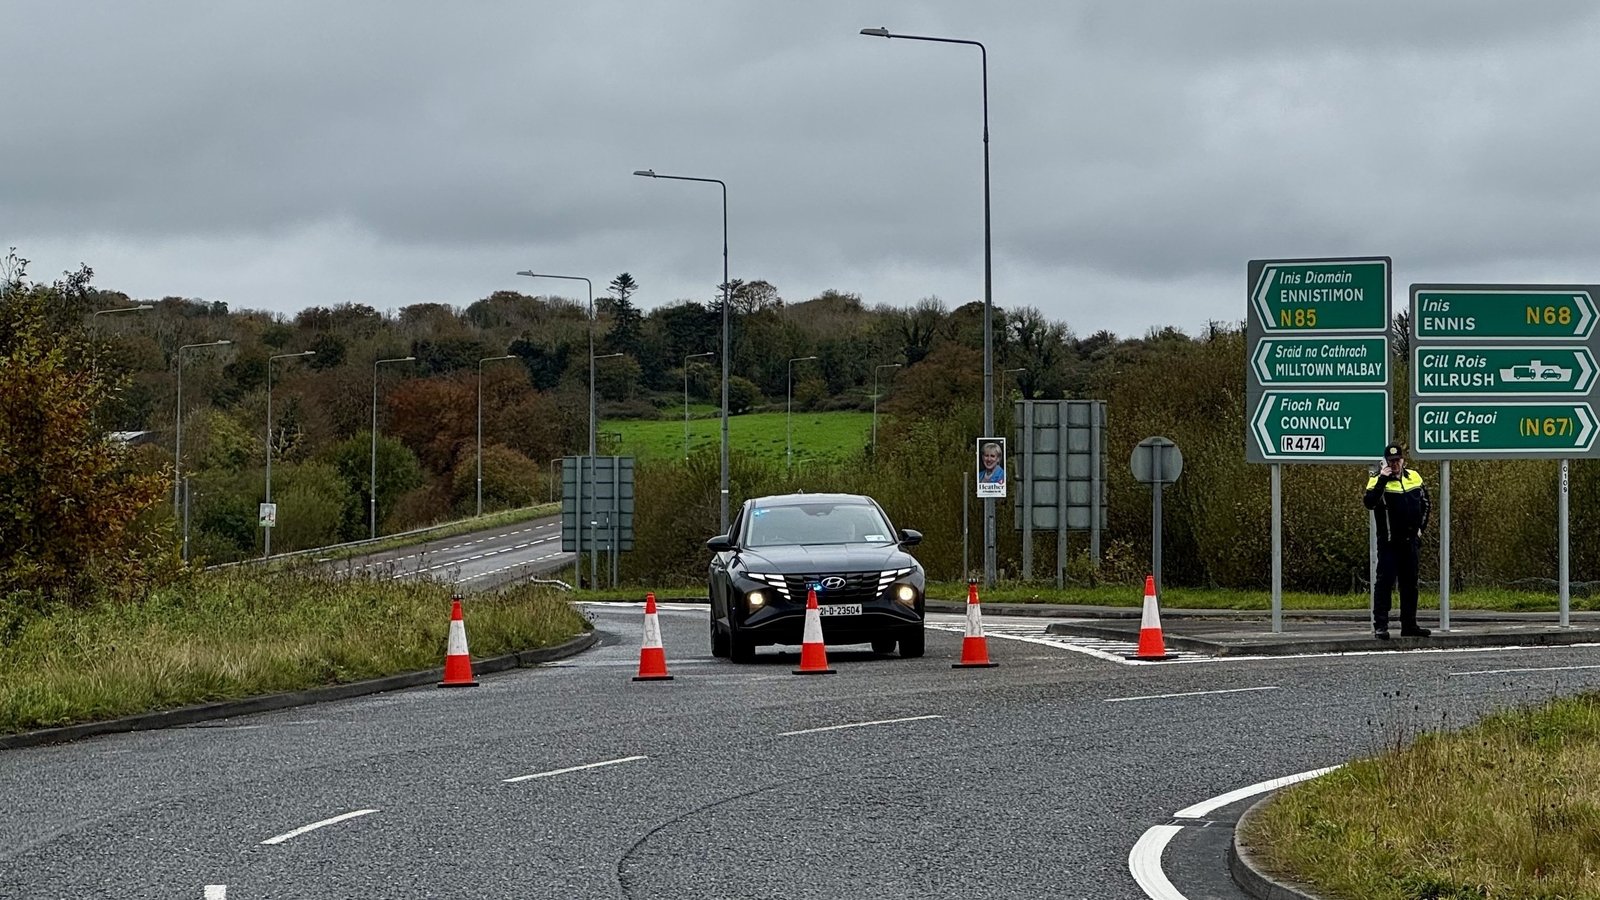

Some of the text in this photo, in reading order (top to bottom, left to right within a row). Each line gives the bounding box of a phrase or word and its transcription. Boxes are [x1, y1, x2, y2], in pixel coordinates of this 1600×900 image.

[1280, 271, 1301, 285] Inis
[1280, 288, 1364, 303] ENNISTIMON
[1422, 298, 1450, 312] Inis
[1281, 308, 1317, 327] N85
[1526, 306, 1571, 325] N68
[1423, 317, 1476, 331] ENNIS
[1305, 348, 1318, 358] na
[1320, 344, 1367, 358] Cathrach
[1423, 354, 1487, 368] Cill Rois
[1275, 362, 1382, 376] MILLTOWN MALBAY
[1424, 373, 1495, 387] KILRUSH
[1316, 398, 1341, 411] Rua
[1280, 416, 1352, 430] CONNOLLY
[1423, 410, 1498, 425] Cill Chaoi
[1519, 417, 1573, 437] (N67)
[1424, 429, 1480, 443] KILKEE
[1282, 437, 1324, 451] (R474)
